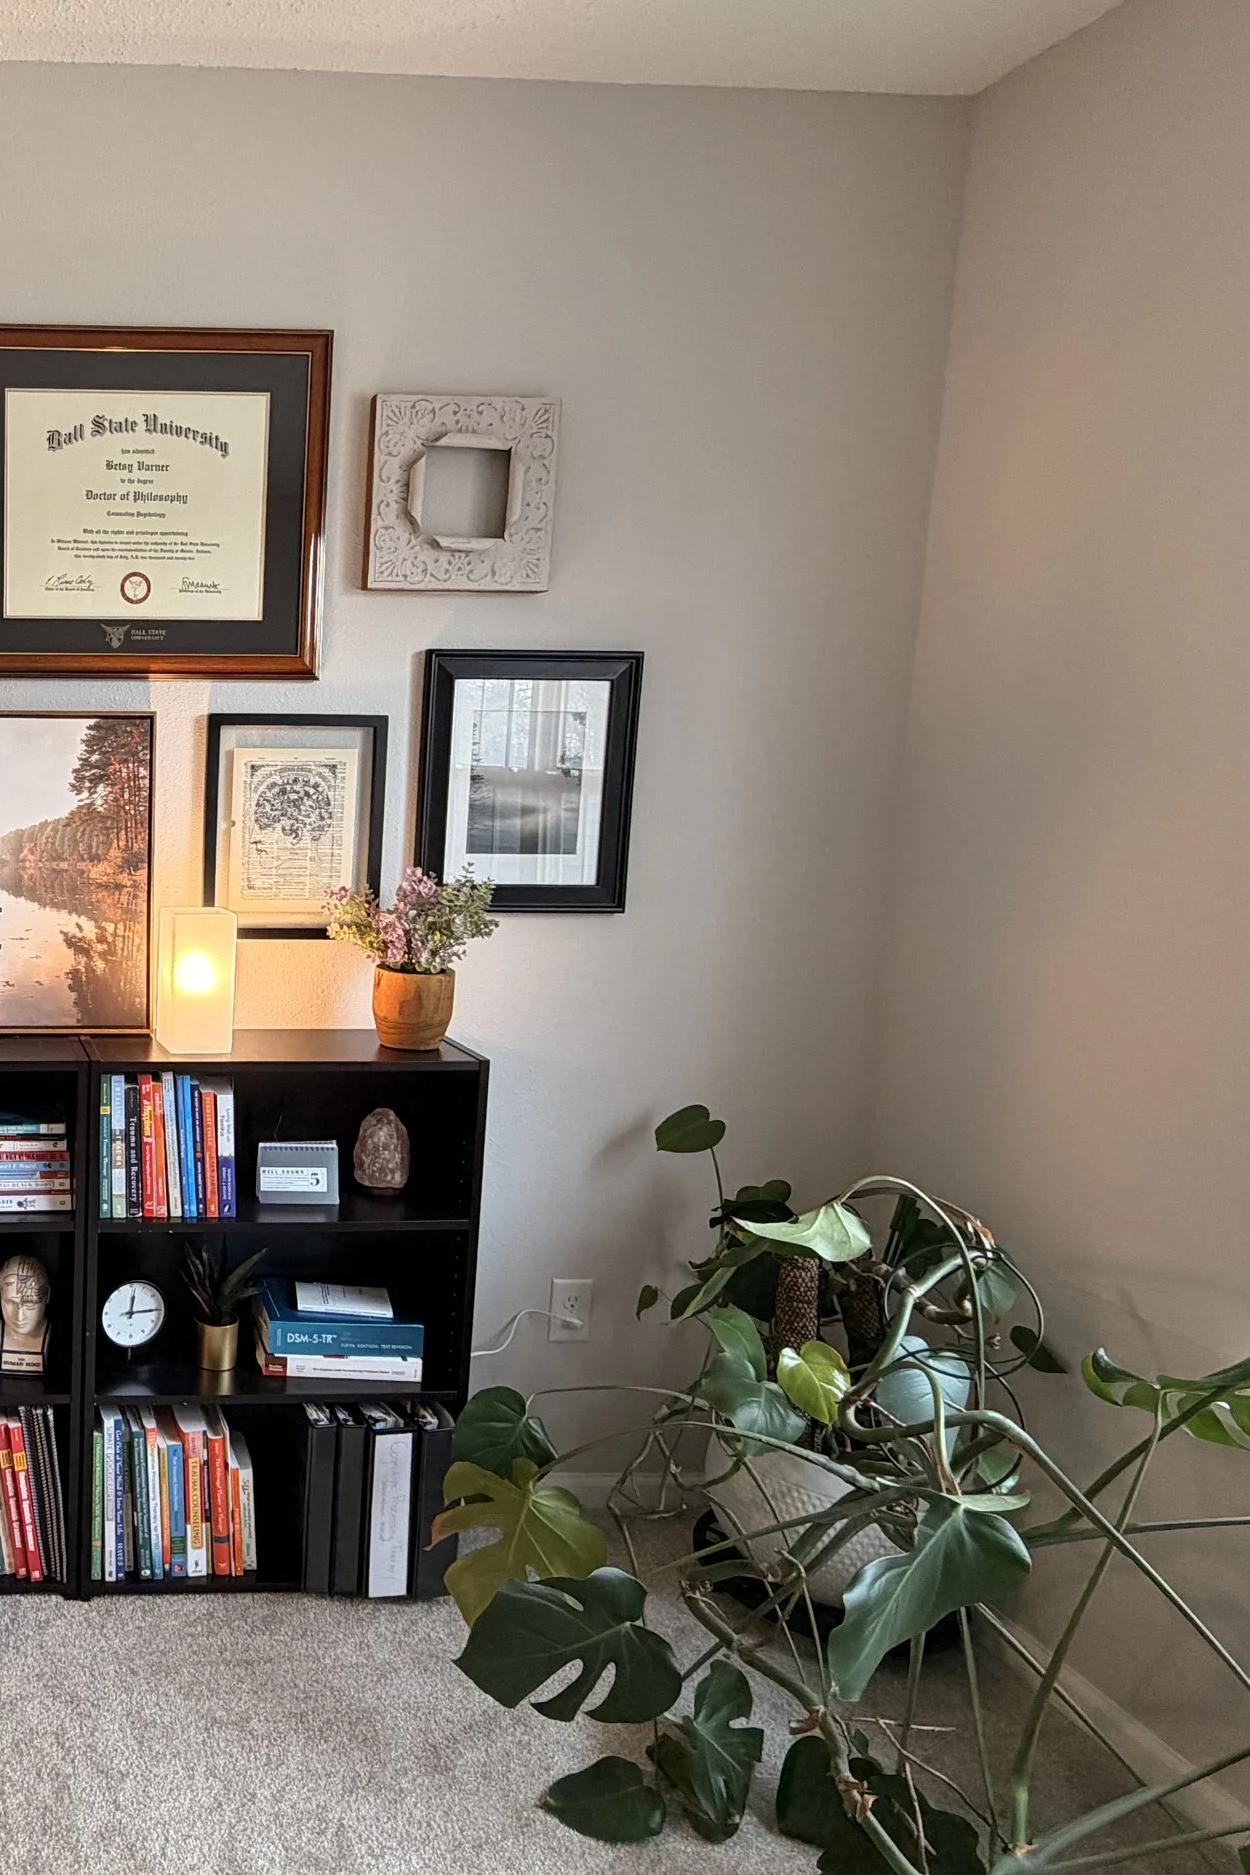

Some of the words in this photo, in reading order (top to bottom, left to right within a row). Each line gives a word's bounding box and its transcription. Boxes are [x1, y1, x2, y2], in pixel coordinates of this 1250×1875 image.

[46, 424, 85, 452] Ball
[90, 414, 139, 438] State
[142, 413, 230, 459] University
[105, 459, 133, 473] Betsy
[137, 460, 170, 472] Varner
[85, 489, 118, 501] Doctor
[120, 490, 131, 501] of
[133, 490, 189, 505] Philosophy
[129, 1116, 137, 1146] Trauma
[142, 1106, 152, 1136] Happiness
[130, 1150, 138, 1163] and
[129, 1167, 139, 1202] Recovery
[310, 1172, 320, 1186] 5
[190, 1460, 198, 1493] TRAUMA
[9, 1497, 18, 1521] Spanish
[21, 1500, 32, 1524] Spanish
[191, 1494, 201, 1545] COUNSELING
